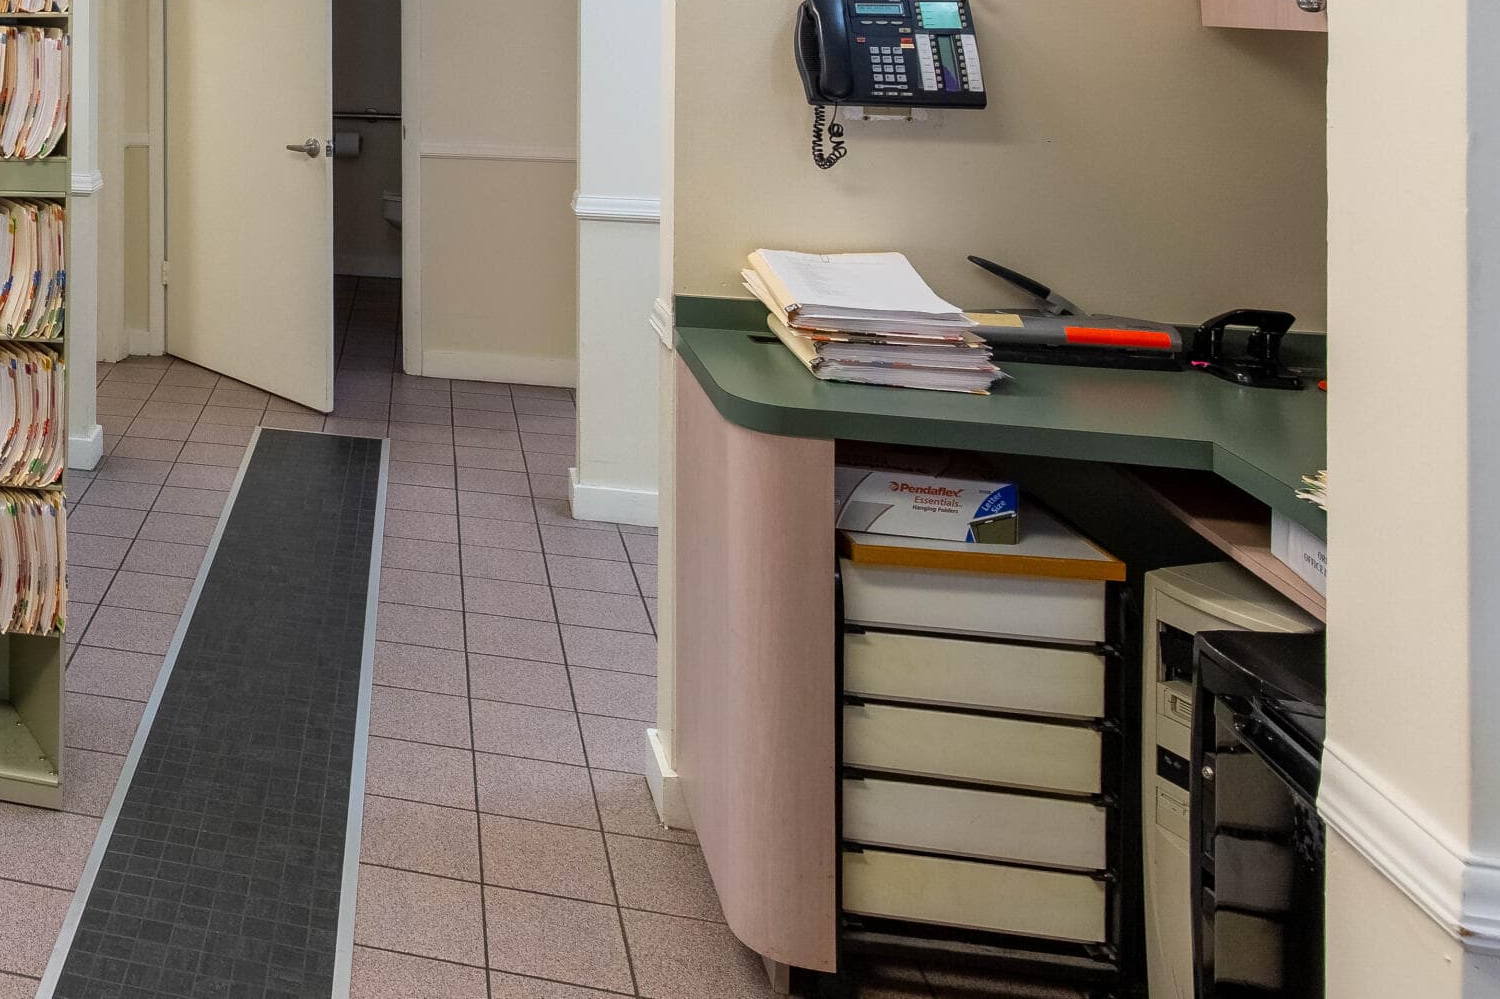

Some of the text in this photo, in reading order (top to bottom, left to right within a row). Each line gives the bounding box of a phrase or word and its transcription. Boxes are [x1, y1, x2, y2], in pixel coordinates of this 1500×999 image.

[900, 483, 964, 498] Pendaflex
[912, 505, 937, 513] Hanging
[914, 496, 959, 508] Essentials
[981, 492, 1002, 512] Letter
[991, 500, 1007, 514] Size
